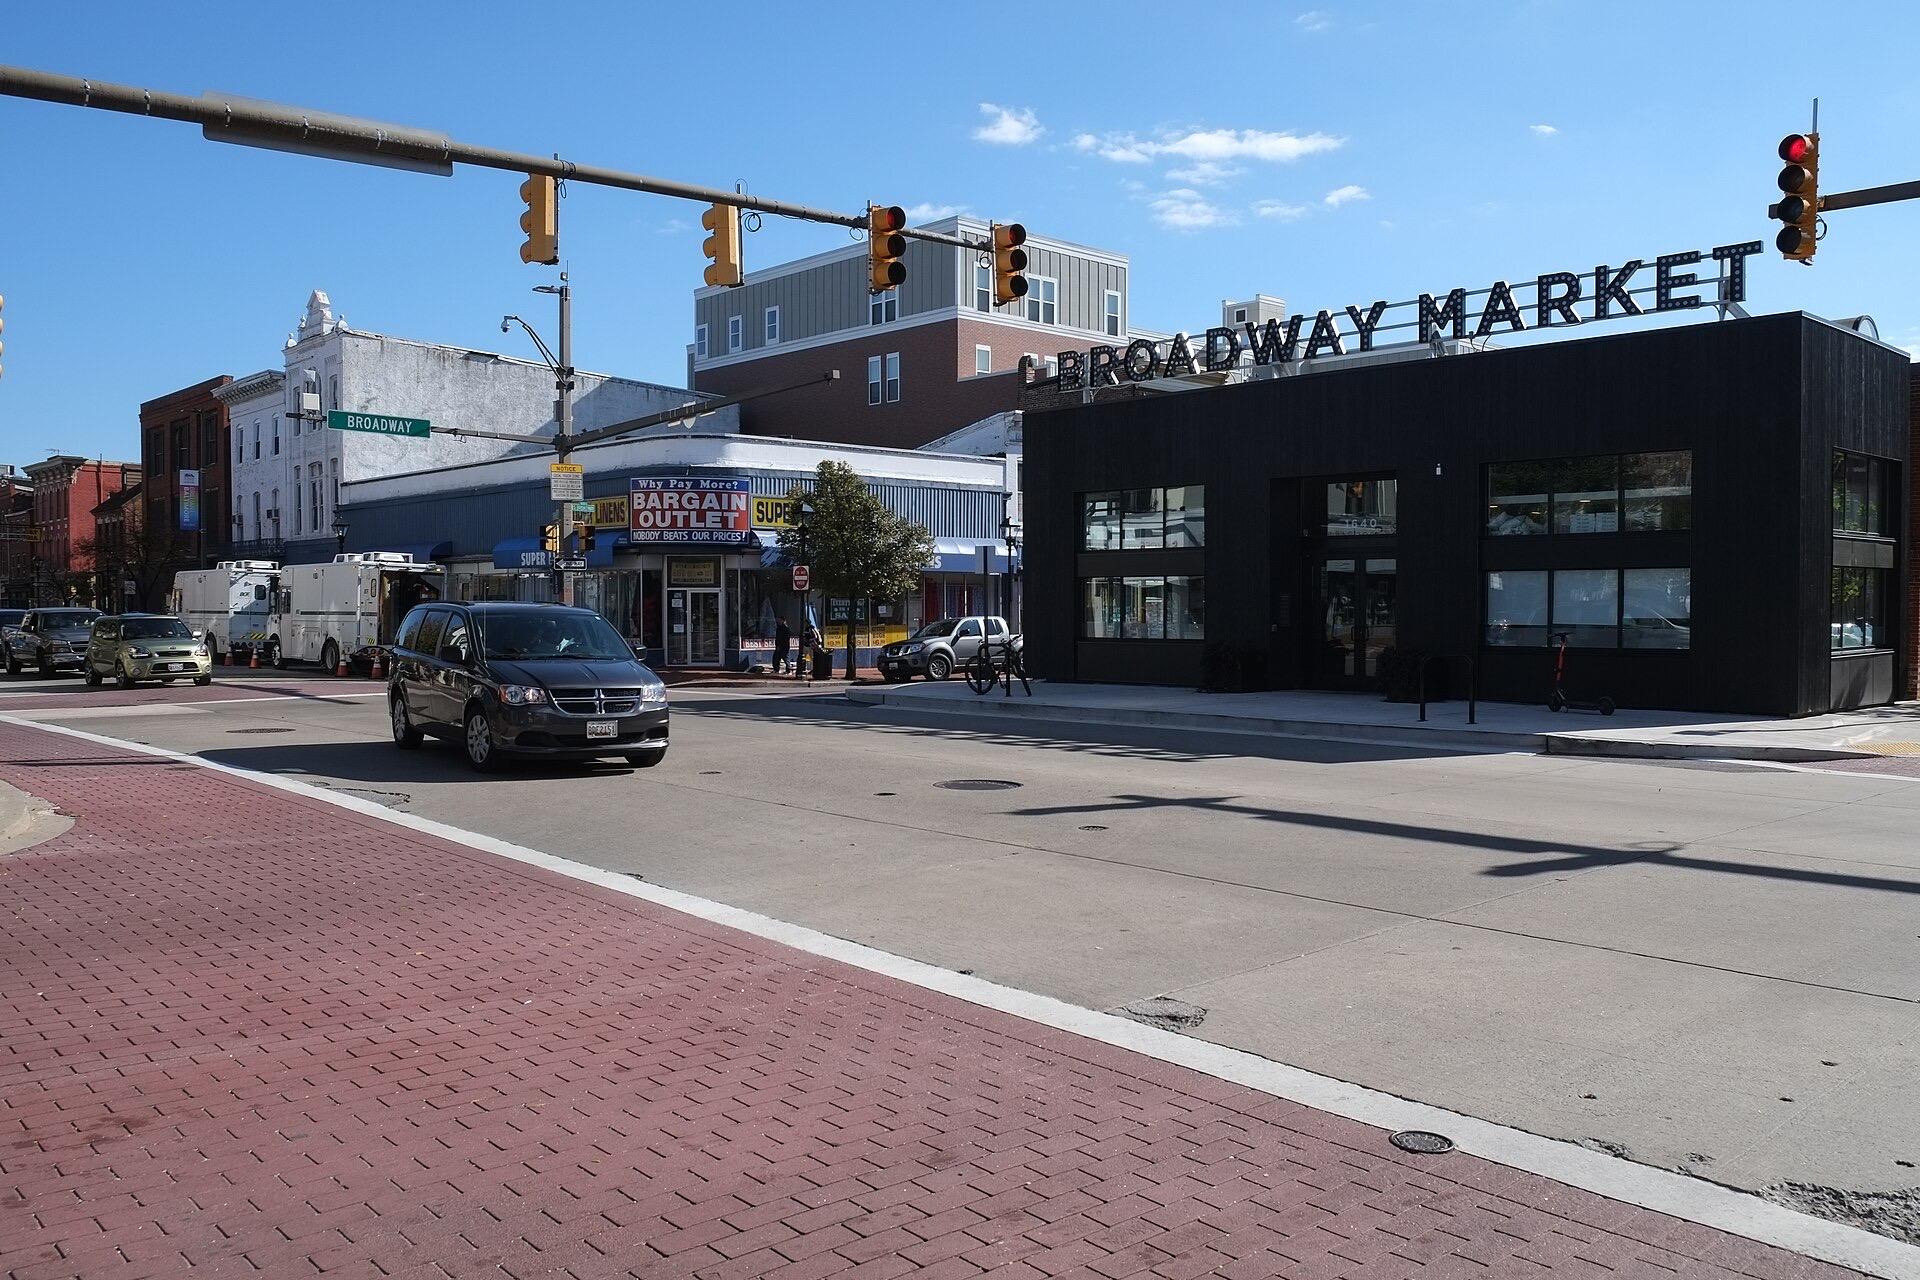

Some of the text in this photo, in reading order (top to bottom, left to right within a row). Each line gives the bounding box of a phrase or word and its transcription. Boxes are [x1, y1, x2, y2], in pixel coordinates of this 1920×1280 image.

[1057, 240, 1764, 391] BROADWAY MARKET
[347, 415, 412, 434] BROADWAY
[638, 479, 739, 490] Why Pay More?
[633, 492, 747, 511] BARGAIN
[595, 501, 625, 524] LINENS
[638, 510, 740, 529] OUTLET
[756, 501, 793, 524] SUPE
[1344, 518, 1378, 529] 1640
[633, 531, 661, 541] NOBODY
[663, 531, 689, 541] BEATS
[691, 531, 710, 541] OUR
[713, 531, 746, 542] PRICES!
[520, 551, 546, 566] SUPER
